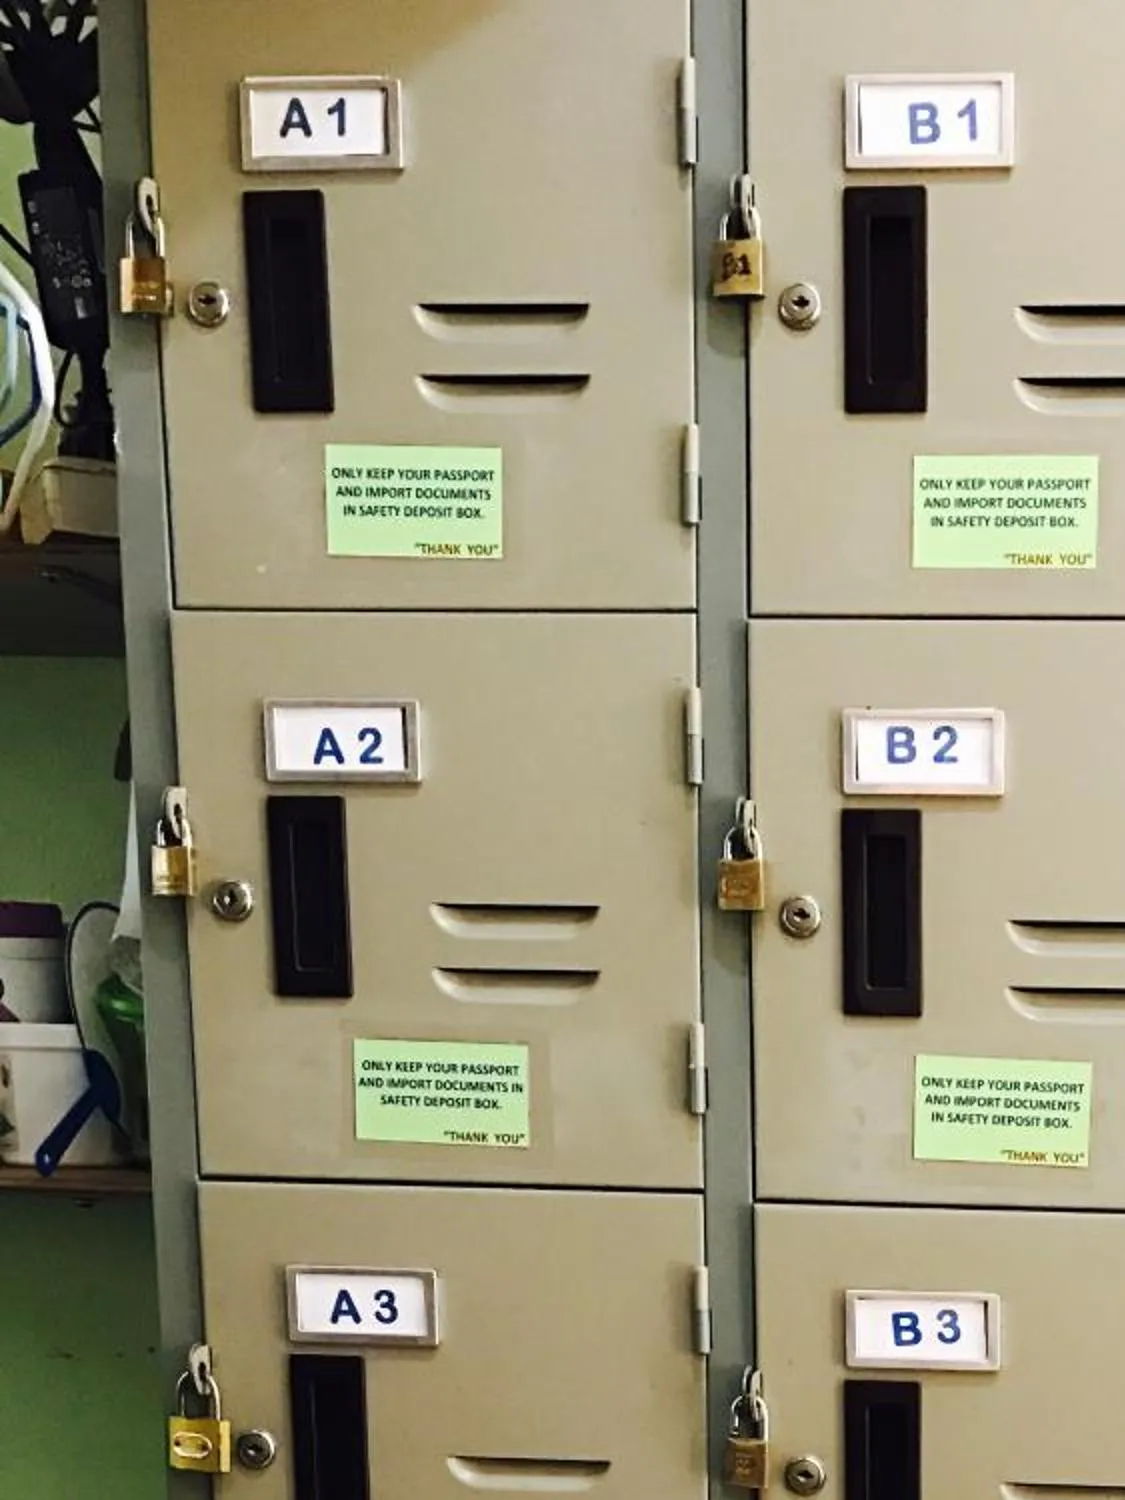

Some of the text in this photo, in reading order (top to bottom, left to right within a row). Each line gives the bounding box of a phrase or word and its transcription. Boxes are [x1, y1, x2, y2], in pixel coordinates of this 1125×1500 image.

[331, 467, 494, 482] ONLY KEEP YOUR PASSPORT
[920, 478, 952, 490] ONLY
[990, 478, 1024, 490] YOUR
[1027, 478, 1090, 490] PASSPORT
[336, 486, 491, 500] AND IMPORT DOCUMENTS
[924, 497, 1086, 509] AND IMPORT DOCUMENTS
[344, 504, 356, 516] IN
[359, 505, 400, 517] SAFETY
[404, 505, 453, 518] DEPOSIT
[930, 516, 944, 527] IN
[948, 516, 991, 527] SAFETY
[994, 516, 1046, 528] DEPOSIT
[362, 1060, 519, 1076] ONLY KEEP YOUR PASSPORT
[358, 1077, 523, 1093] AND IMPORT DOCUMENTS IN
[922, 1076, 1084, 1094] ONLY KEEP YOUR PASSPORT
[380, 1094, 420, 1107] SAFETY
[424, 1096, 472, 1109] DEPOSIT
[925, 1094, 1080, 1112] AND IMPORT DOCUMENTS
[931, 1112, 944, 1122] IN
[948, 1112, 988, 1125] SAFETY
[992, 1115, 1041, 1127] DEPOSIT
